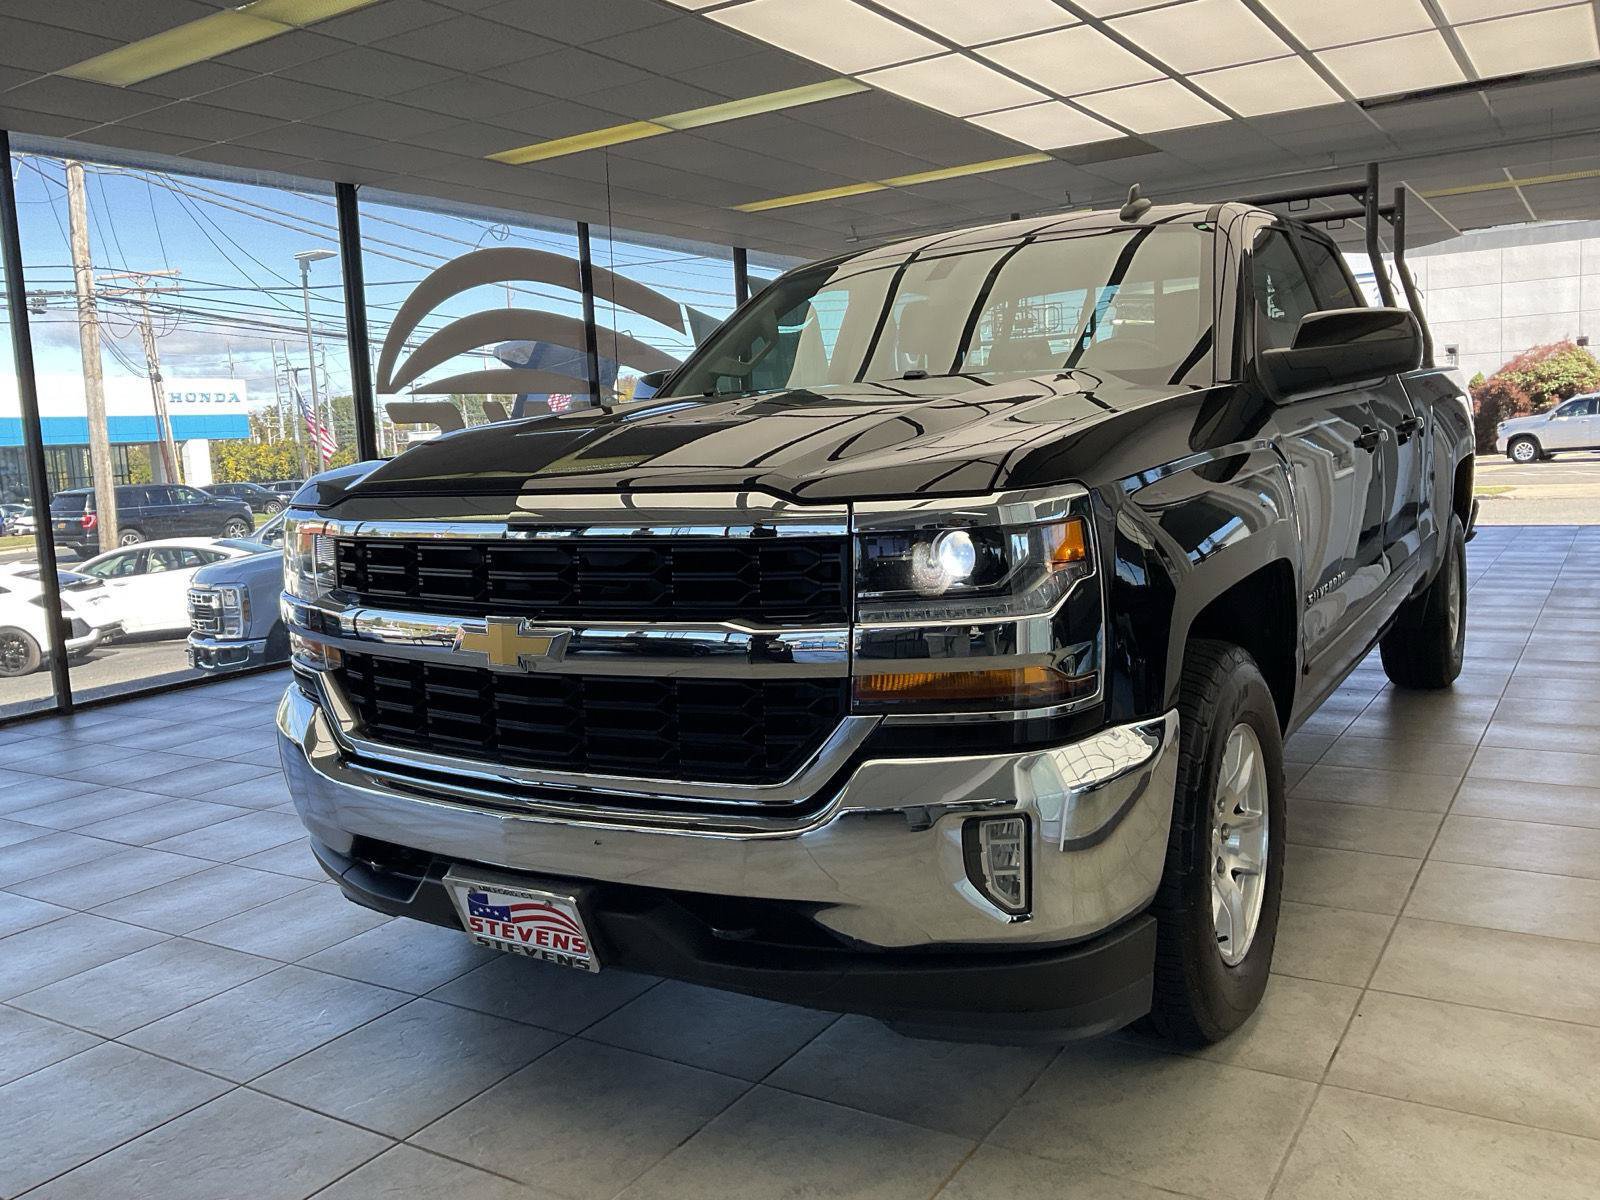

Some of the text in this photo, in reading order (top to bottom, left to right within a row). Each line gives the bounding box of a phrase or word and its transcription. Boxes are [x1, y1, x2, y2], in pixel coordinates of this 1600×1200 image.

[168, 391, 241, 403] HONDA
[469, 916, 588, 954] STEVENS
[476, 936, 591, 970] STEVENS
